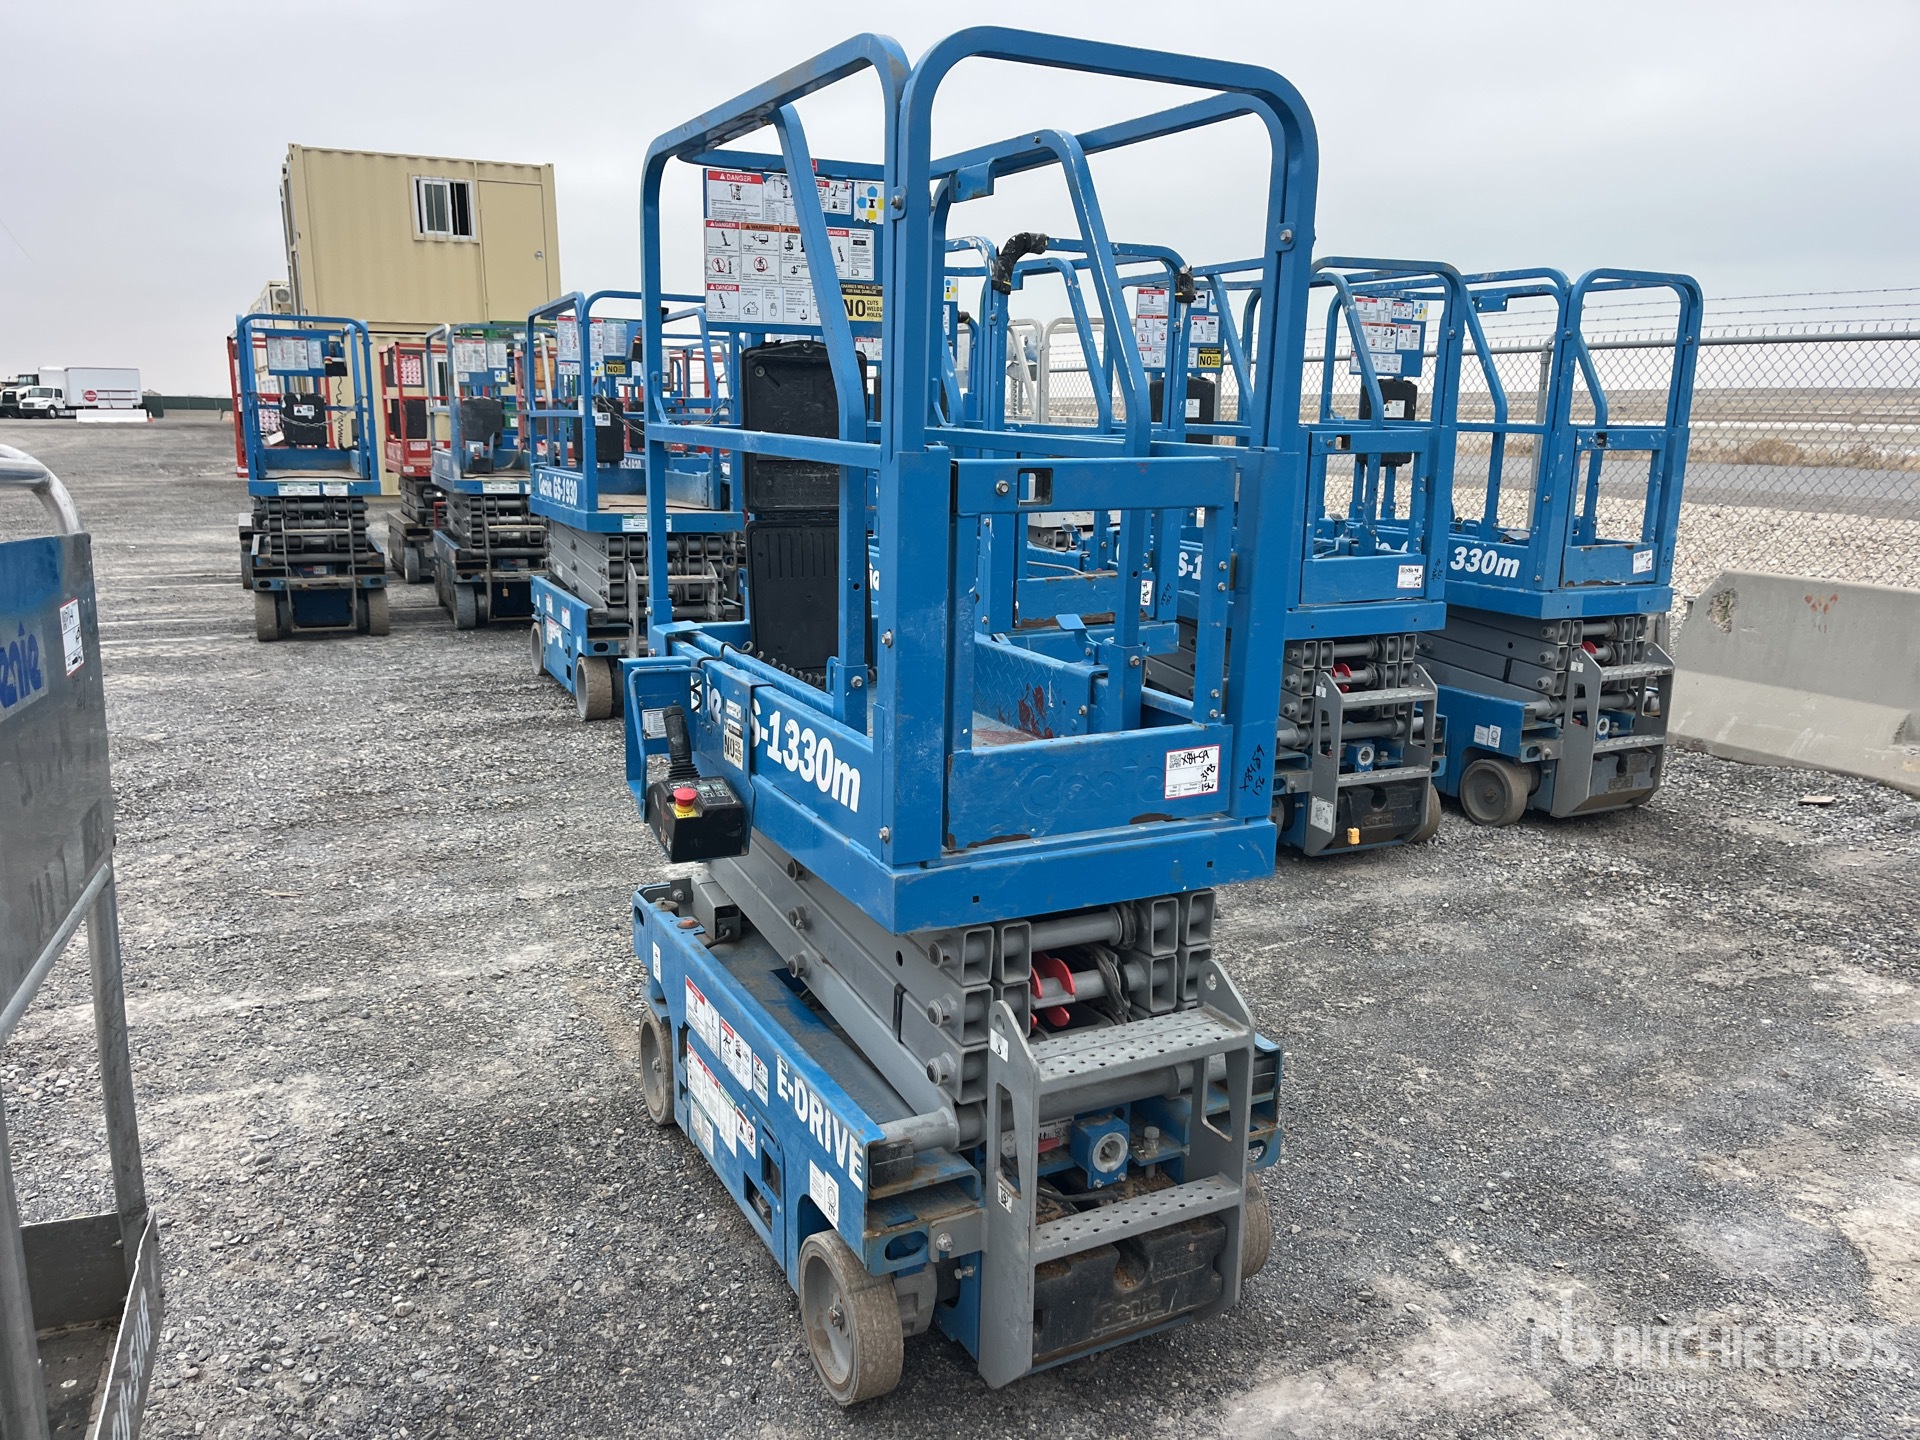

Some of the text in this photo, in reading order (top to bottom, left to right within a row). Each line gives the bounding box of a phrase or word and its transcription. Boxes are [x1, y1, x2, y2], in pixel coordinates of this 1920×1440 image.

[727, 173, 752, 182] DANGER
[844, 299, 866, 317] NO
[607, 364, 618, 373] NO
[1199, 356, 1212, 365] NO
[553, 475, 578, 506] GS-1930
[1450, 546, 1520, 578] 330m
[724, 734, 735, 757] NO
[776, 1055, 864, 1192] E-DRIVE
